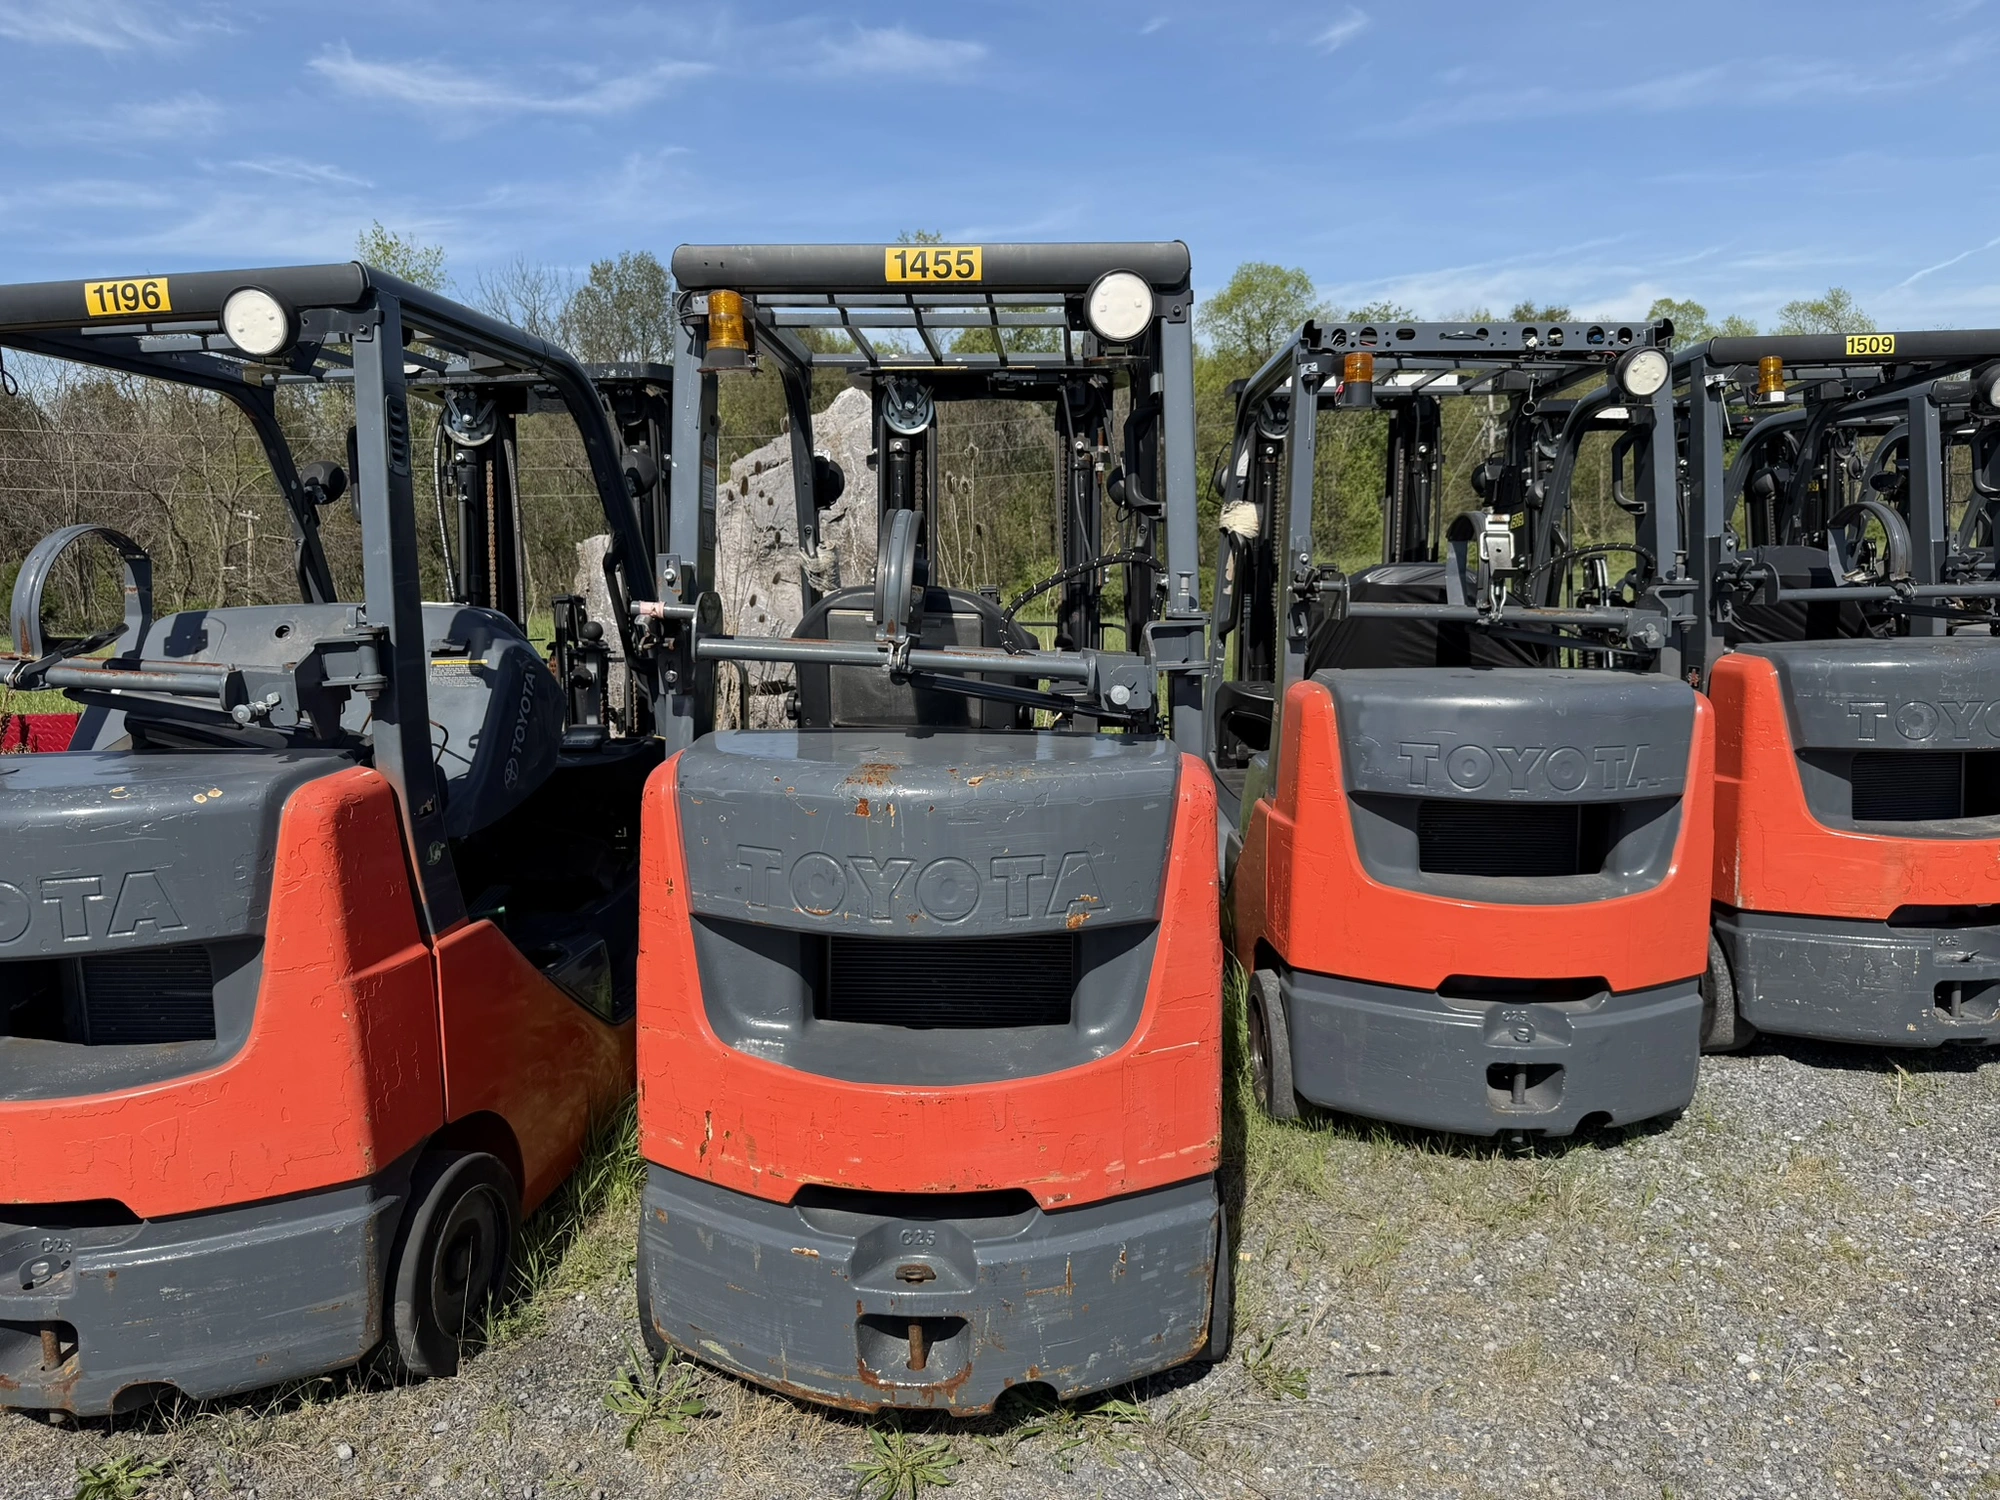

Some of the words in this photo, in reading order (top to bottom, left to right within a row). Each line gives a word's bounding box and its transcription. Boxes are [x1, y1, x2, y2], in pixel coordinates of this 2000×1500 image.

[894, 250, 975, 279] 1455
[93, 281, 161, 312] 1196
[1847, 336, 1893, 354] 1509
[511, 672, 536, 754] TOYOTA
[1397, 742, 1661, 794] TOYOTA
[737, 844, 1110, 925] TOYOTA
[898, 1228, 936, 1247] C25
